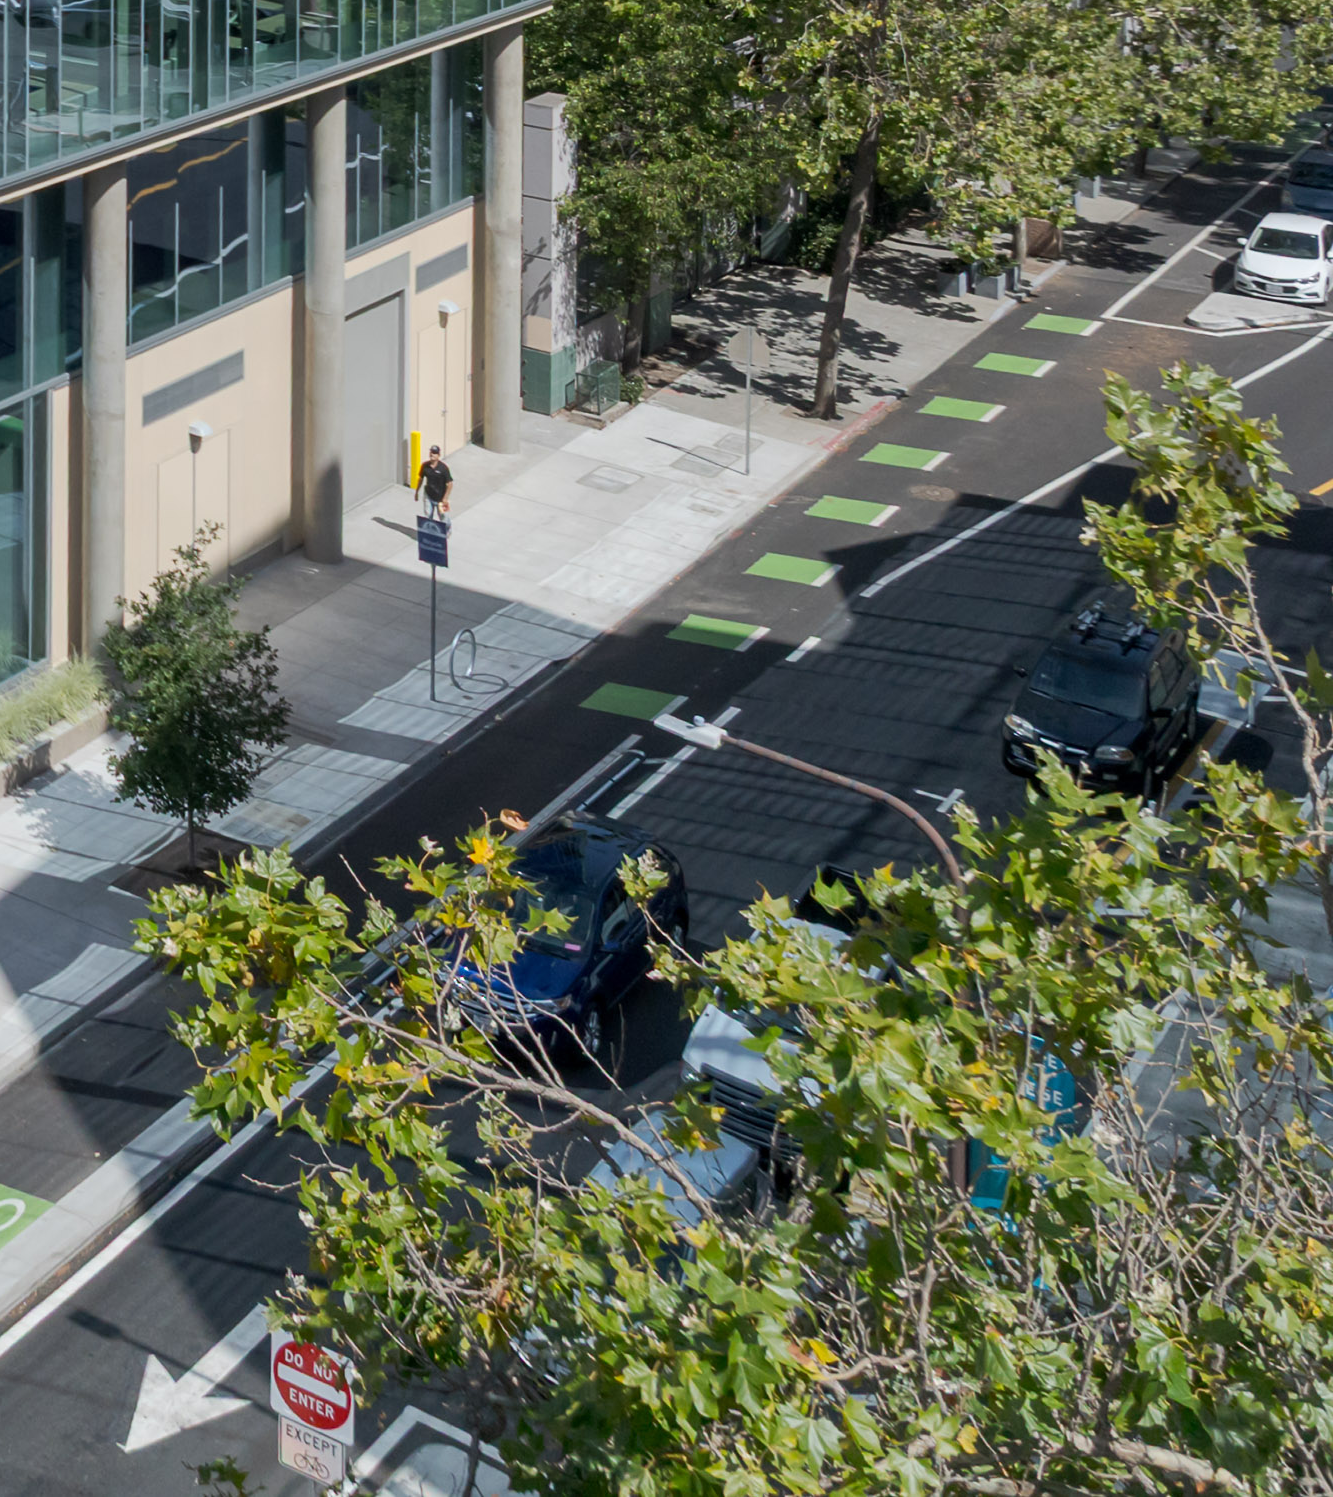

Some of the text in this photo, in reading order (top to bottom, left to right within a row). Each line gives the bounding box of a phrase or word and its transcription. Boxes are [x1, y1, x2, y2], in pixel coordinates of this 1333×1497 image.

[284, 1348, 337, 1382] DO NO
[289, 1386, 334, 1421] ENTER
[286, 1423, 338, 1457] EXCEPT
